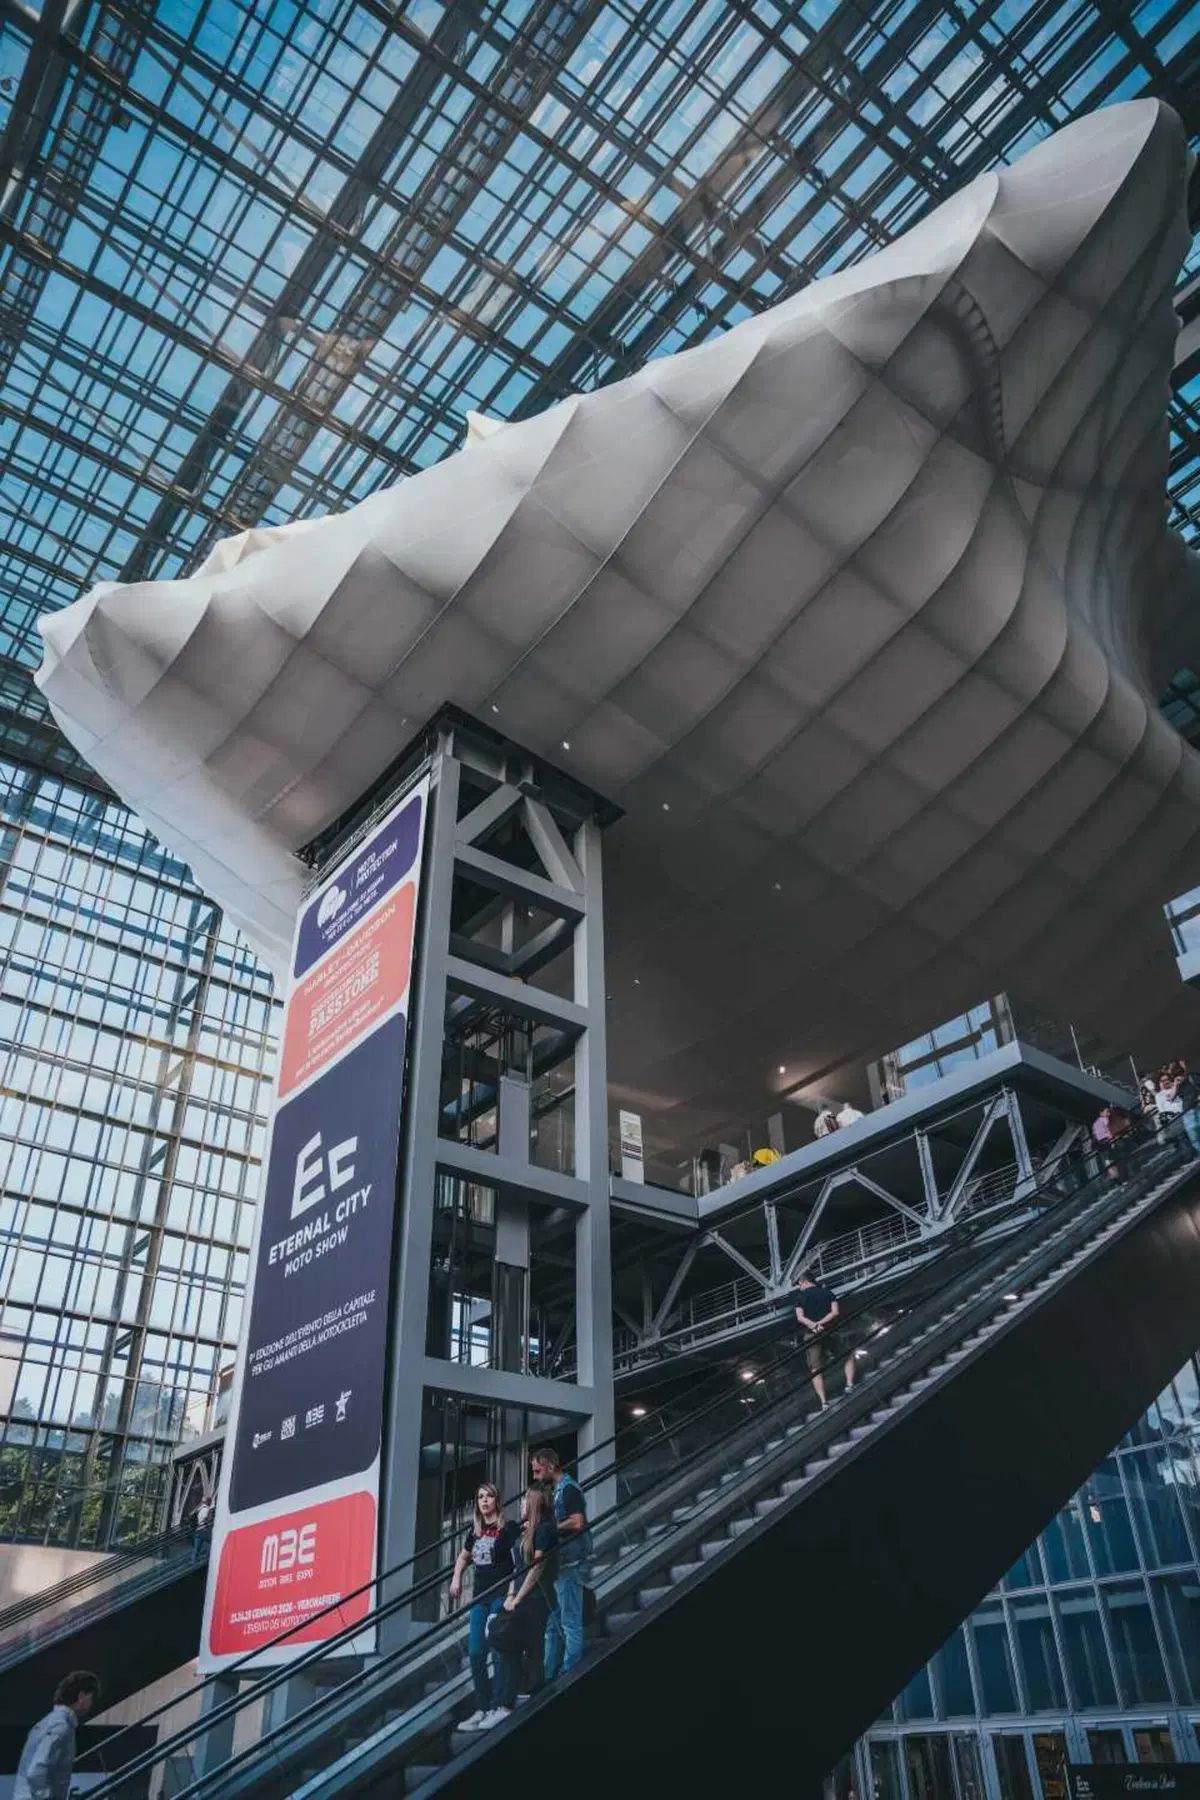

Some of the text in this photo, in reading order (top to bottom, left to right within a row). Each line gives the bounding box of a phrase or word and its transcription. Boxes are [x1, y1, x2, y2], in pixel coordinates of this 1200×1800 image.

[268, 1184, 372, 1266] ETERNAL CITY
[284, 1225, 349, 1278] MOTO SHOW
[323, 1307, 342, 1326] DELLA
[343, 1289, 376, 1314] CAPITALE
[251, 1362, 263, 1377] PER
[298, 1335, 316, 1354] DELLA
[317, 1310, 367, 1343] MOTOCICLETTA
